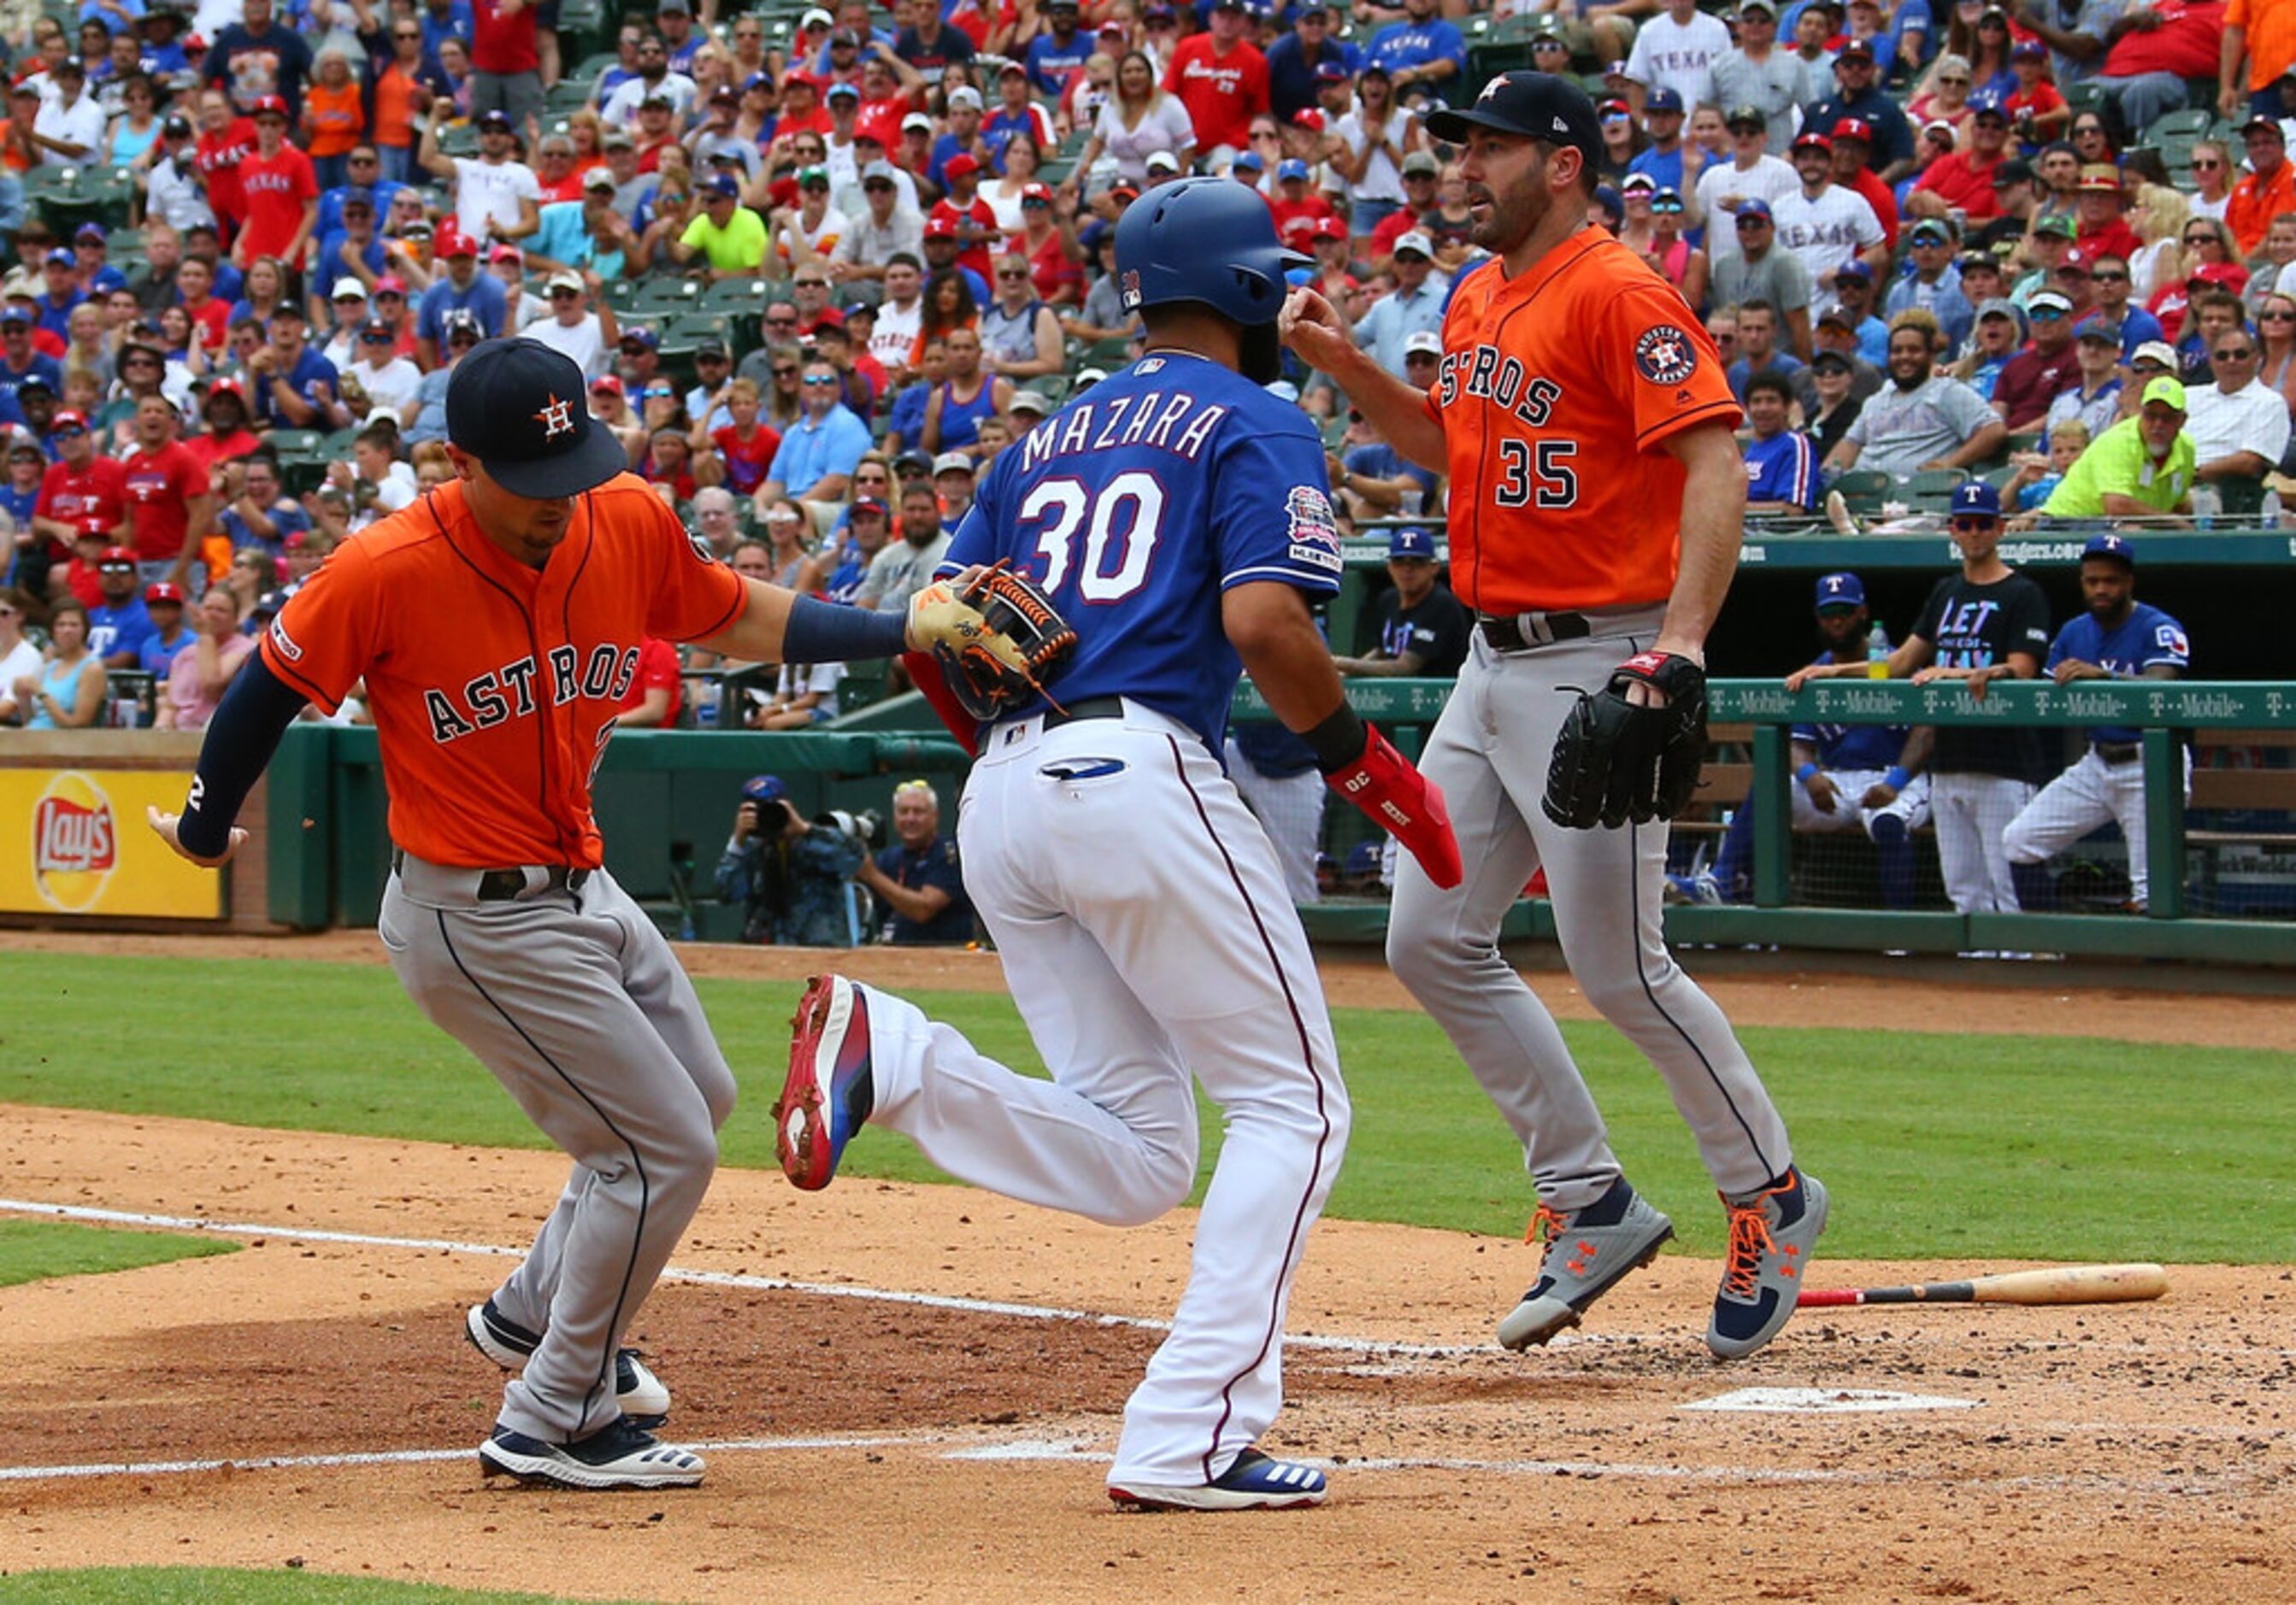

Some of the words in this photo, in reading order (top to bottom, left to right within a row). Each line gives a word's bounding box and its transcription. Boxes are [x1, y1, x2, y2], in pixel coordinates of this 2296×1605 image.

[1651, 51, 1721, 72] TEXA
[1848, 119, 1862, 132] T
[539, 400, 573, 436] H
[1021, 392, 1227, 471] MAZARA
[1497, 438, 1577, 509] 35
[1964, 485, 1981, 503] T
[1019, 470, 1169, 605] 30
[1401, 533, 1417, 548] T
[2104, 535, 2121, 550] T
[156, 582, 171, 597] T
[1827, 576, 1843, 592] T
[1937, 597, 1999, 637] LET
[87, 626, 117, 661] T
[424, 643, 639, 744] ASTROS
[187, 773, 205, 812] 2
[39, 801, 110, 871] Lay's
[1366, 846, 1380, 861] T
